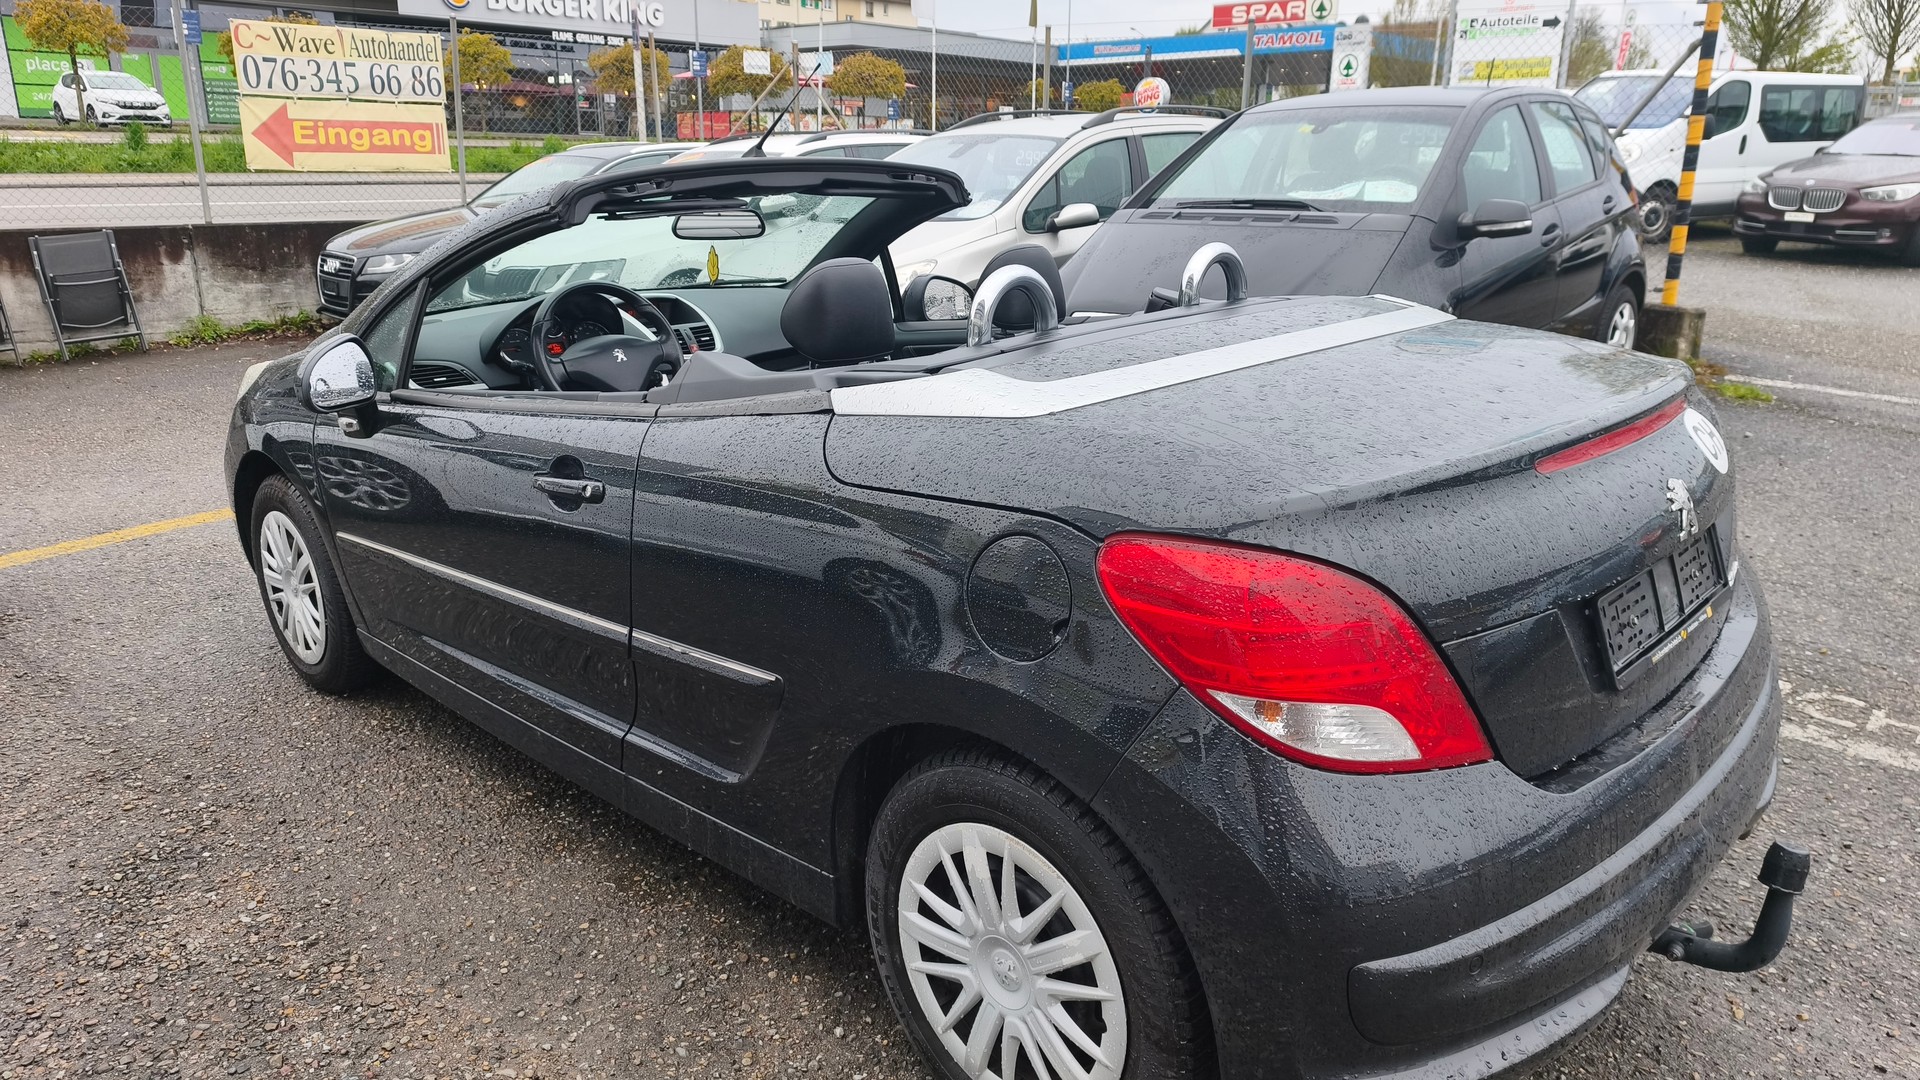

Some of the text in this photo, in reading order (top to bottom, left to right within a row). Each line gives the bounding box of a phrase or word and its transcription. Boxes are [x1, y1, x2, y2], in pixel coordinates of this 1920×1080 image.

[601, 0, 665, 27] KING
[1231, 1, 1306, 25] SPAR
[1480, 15, 1539, 28] Autoteile
[349, 34, 440, 63] Autohandel
[552, 31, 575, 42] FLAME
[575, 33, 606, 45] GRILLING
[1254, 30, 1325, 49] TAMOIL
[25, 56, 70, 73] place
[369, 63, 402, 96] 66
[411, 65, 442, 97] 86
[1136, 91, 1161, 106] KING
[292, 120, 432, 152] Eingang
